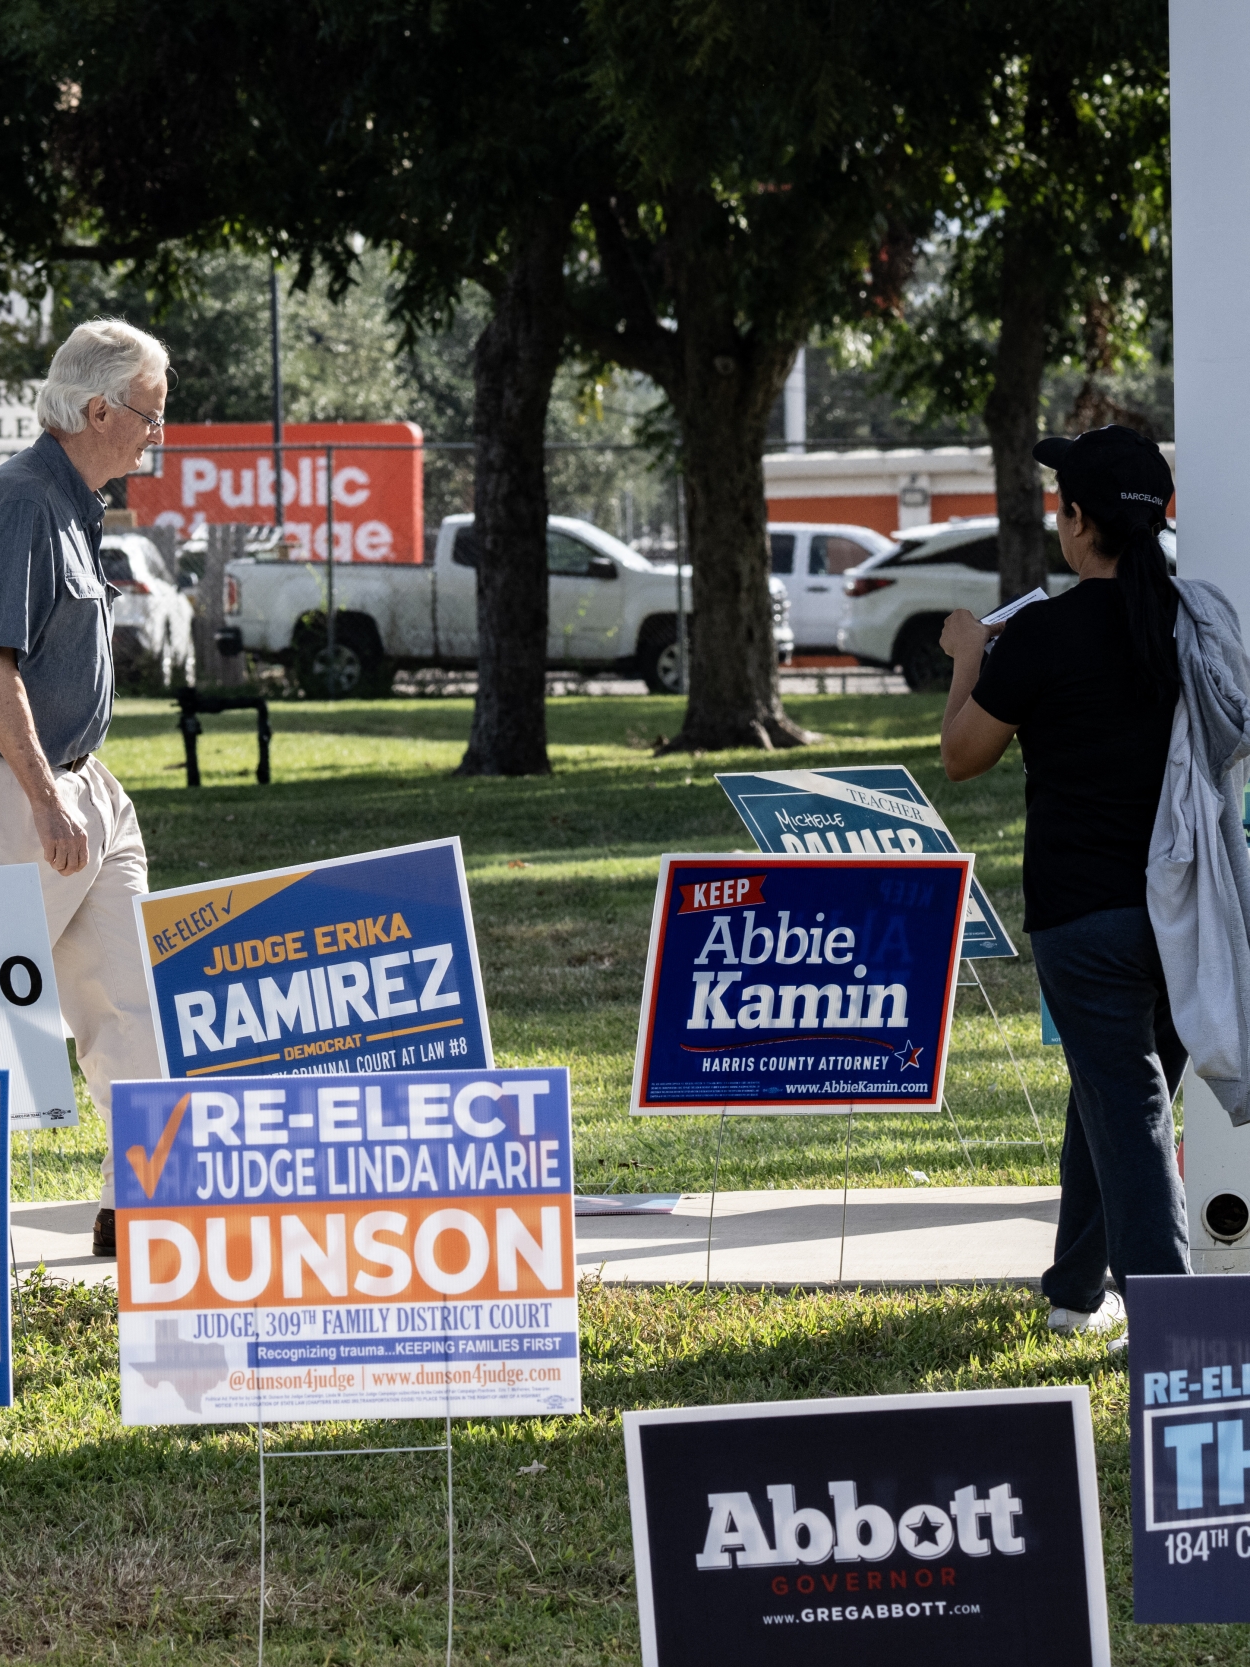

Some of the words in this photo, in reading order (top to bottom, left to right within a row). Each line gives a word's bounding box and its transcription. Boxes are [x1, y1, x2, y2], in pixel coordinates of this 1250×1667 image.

[181, 456, 371, 508] Public
[1120, 492, 1163, 507] BARCELONA
[845, 787, 925, 823] TEACHER
[693, 877, 751, 909] KEEP
[152, 901, 220, 956] RE-ELECT
[203, 930, 308, 976] JUDGE
[314, 912, 412, 955] ERIKA
[693, 910, 857, 966] Abbie
[173, 942, 461, 1058] RAMIREZ
[685, 963, 909, 1030] Kamin
[283, 1033, 363, 1062] DEMOCRAT
[356, 1050, 397, 1074] COURT
[401, 1046, 417, 1067] AT
[420, 1040, 445, 1063] LAW
[449, 1036, 468, 1058] #8
[702, 1057, 755, 1073] HARRIS
[759, 1056, 815, 1072] COUNTY
[818, 1055, 890, 1072] ATTORNEY
[785, 1080, 929, 1095] www.AbbieKamin.com
[190, 1080, 550, 1148] RE-ELECT
[195, 1148, 316, 1202] JUDGE
[328, 1143, 440, 1195] LINDA
[448, 1139, 561, 1190] MARIE
[128, 1206, 563, 1305] DUNSON
[193, 1312, 260, 1342] JUDGE,
[265, 1309, 318, 1338] 309TH
[322, 1307, 391, 1337] FAMILY
[396, 1304, 484, 1334] DISTRICT
[489, 1302, 552, 1330] COURT
[257, 1346, 337, 1366] Recognizing
[458, 1339, 521, 1356] FAMILIES
[523, 1337, 562, 1354] FIRST
[228, 1368, 356, 1395] @dunson4judge
[372, 1361, 562, 1390] www.dunson4judge.com
[695, 1479, 1026, 1571] Abbott
[1164, 1529, 1229, 1565] 184TH
[770, 1567, 957, 1596] GOVERNOR
